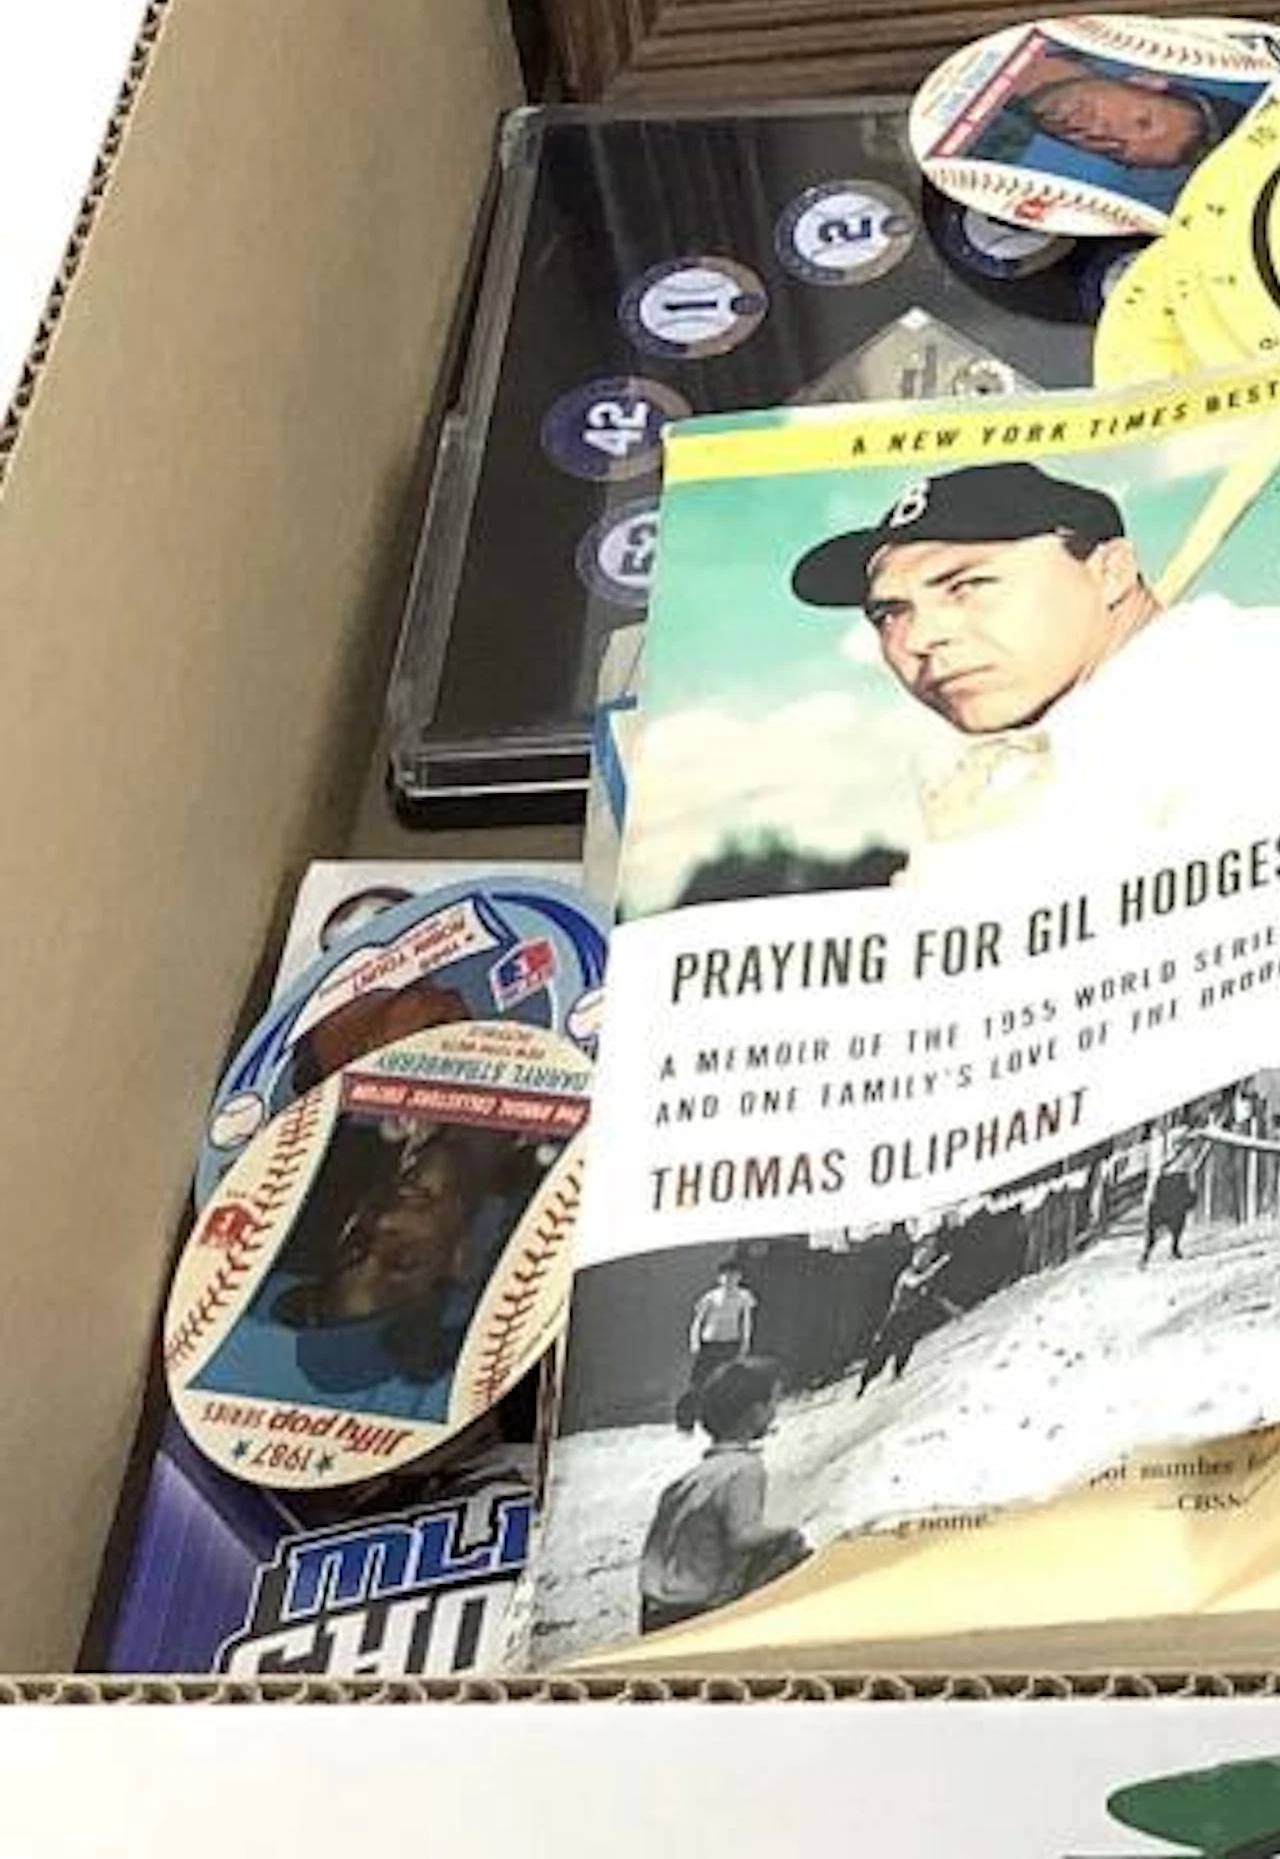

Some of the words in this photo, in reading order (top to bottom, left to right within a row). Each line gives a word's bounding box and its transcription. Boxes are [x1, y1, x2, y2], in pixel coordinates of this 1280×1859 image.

[818, 216, 873, 245] 2
[583, 398, 648, 459] 42
[851, 436, 866, 456] A
[888, 429, 961, 453] NEW
[980, 421, 1068, 446] YORK
[1089, 404, 1189, 440] TIMES
[890, 478, 929, 528] B
[671, 934, 889, 1005] PRAYING
[913, 920, 1005, 981] FOR
[1027, 896, 1098, 958] GIL
[660, 1053, 677, 1082] A
[696, 1038, 831, 1076] MEMOIR
[849, 1033, 884, 1061] OF
[908, 1021, 961, 1053] THE
[984, 998, 1058, 1040] 1955
[1074, 959, 1177, 1011] WORLD
[655, 1097, 720, 1128] AND
[740, 1086, 801, 1115] ONE
[820, 1063, 975, 1110] FAMILY'S
[990, 1036, 1058, 1081] LOVE
[1077, 1019, 1113, 1052] OF
[1131, 996, 1183, 1034] THE
[649, 1147, 848, 1213] THOMAS
[870, 1084, 1091, 1187] OLIPHANT
[251, 1442, 314, 1473] 1987
